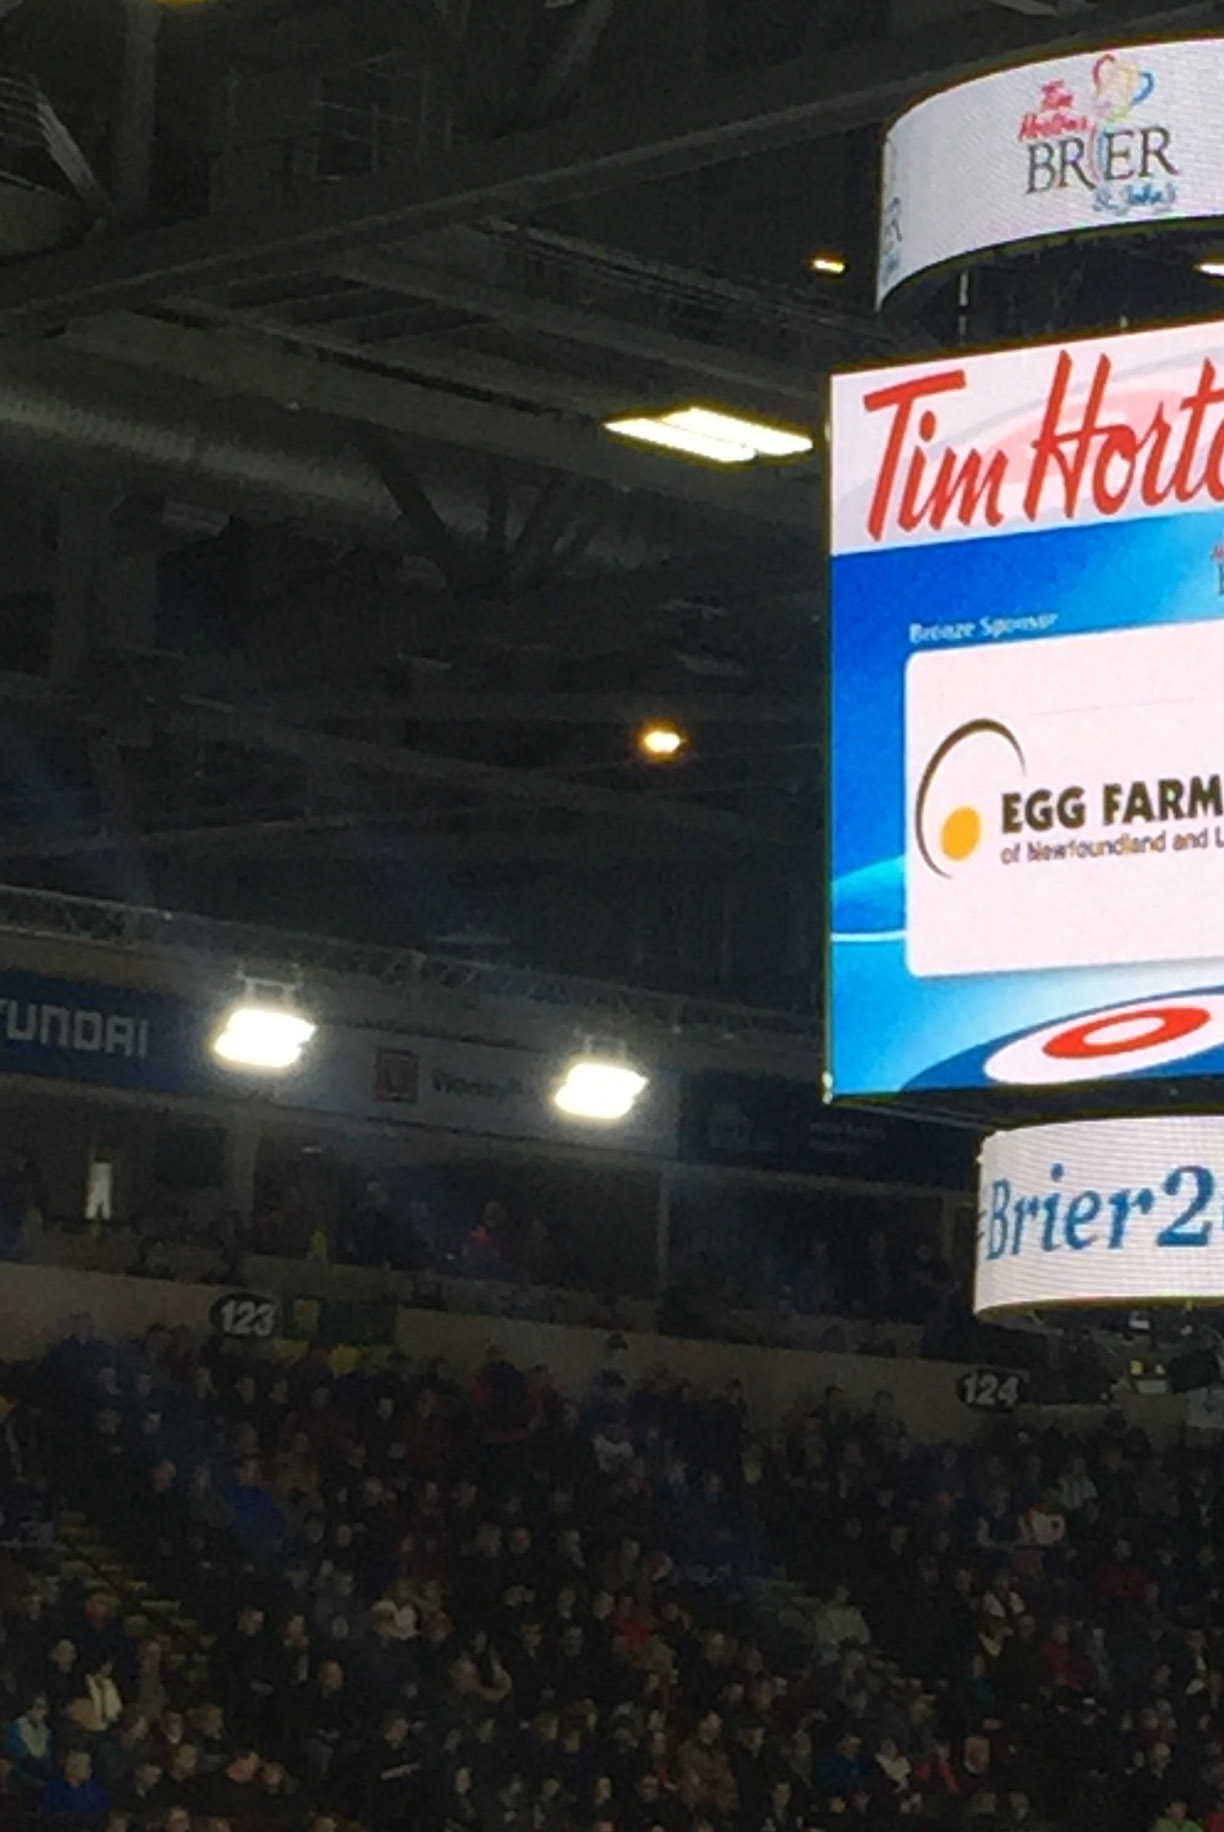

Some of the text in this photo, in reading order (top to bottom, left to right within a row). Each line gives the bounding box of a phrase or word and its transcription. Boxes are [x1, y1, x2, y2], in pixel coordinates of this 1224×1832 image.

[863, 368, 1009, 543] Tim
[1001, 787, 1087, 834] EGG
[1001, 841, 1021, 867] of
[1026, 831, 1168, 863] Newfoundland
[1172, 828, 1210, 853] and
[221, 1298, 276, 1338] 123
[963, 1373, 1020, 1408] 124
